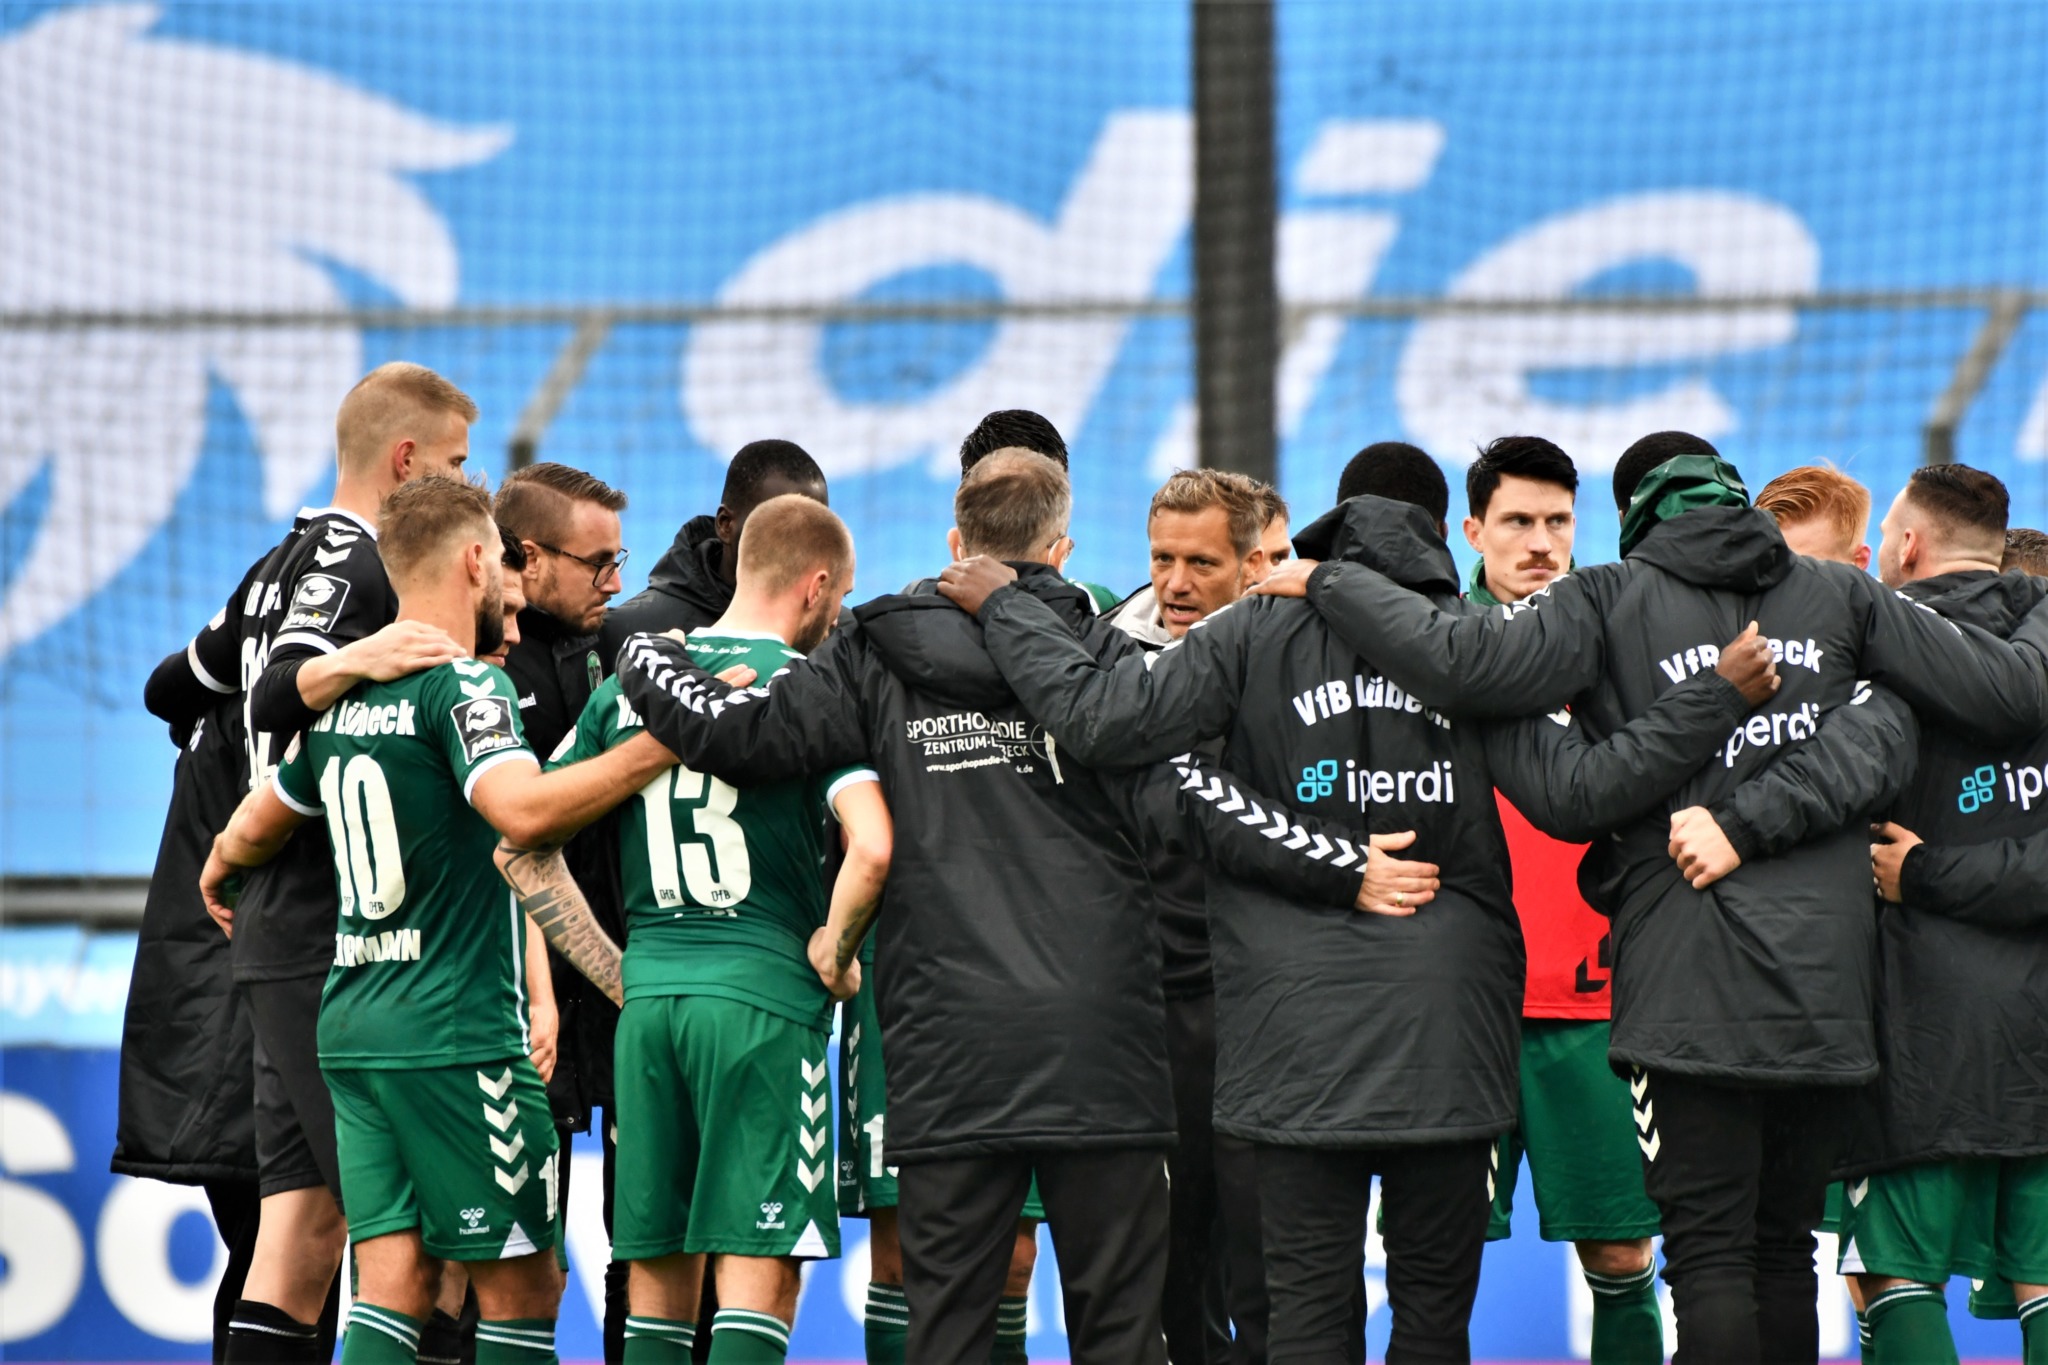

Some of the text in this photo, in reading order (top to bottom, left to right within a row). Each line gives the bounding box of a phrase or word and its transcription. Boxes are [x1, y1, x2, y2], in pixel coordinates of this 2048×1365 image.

[682, 108, 1821, 482] die
[1659, 638, 1823, 684] VfB eck
[1293, 674, 1451, 730] VfB Lübe
[1715, 702, 1820, 768] perdi
[1346, 759, 1453, 813] iperdi
[2002, 761, 2048, 811] ip
[319, 753, 406, 920] 10
[638, 763, 752, 909] 13
[863, 1113, 900, 1178] 1
[459, 1225, 490, 1236] hummel
[756, 1220, 785, 1230] hummel
